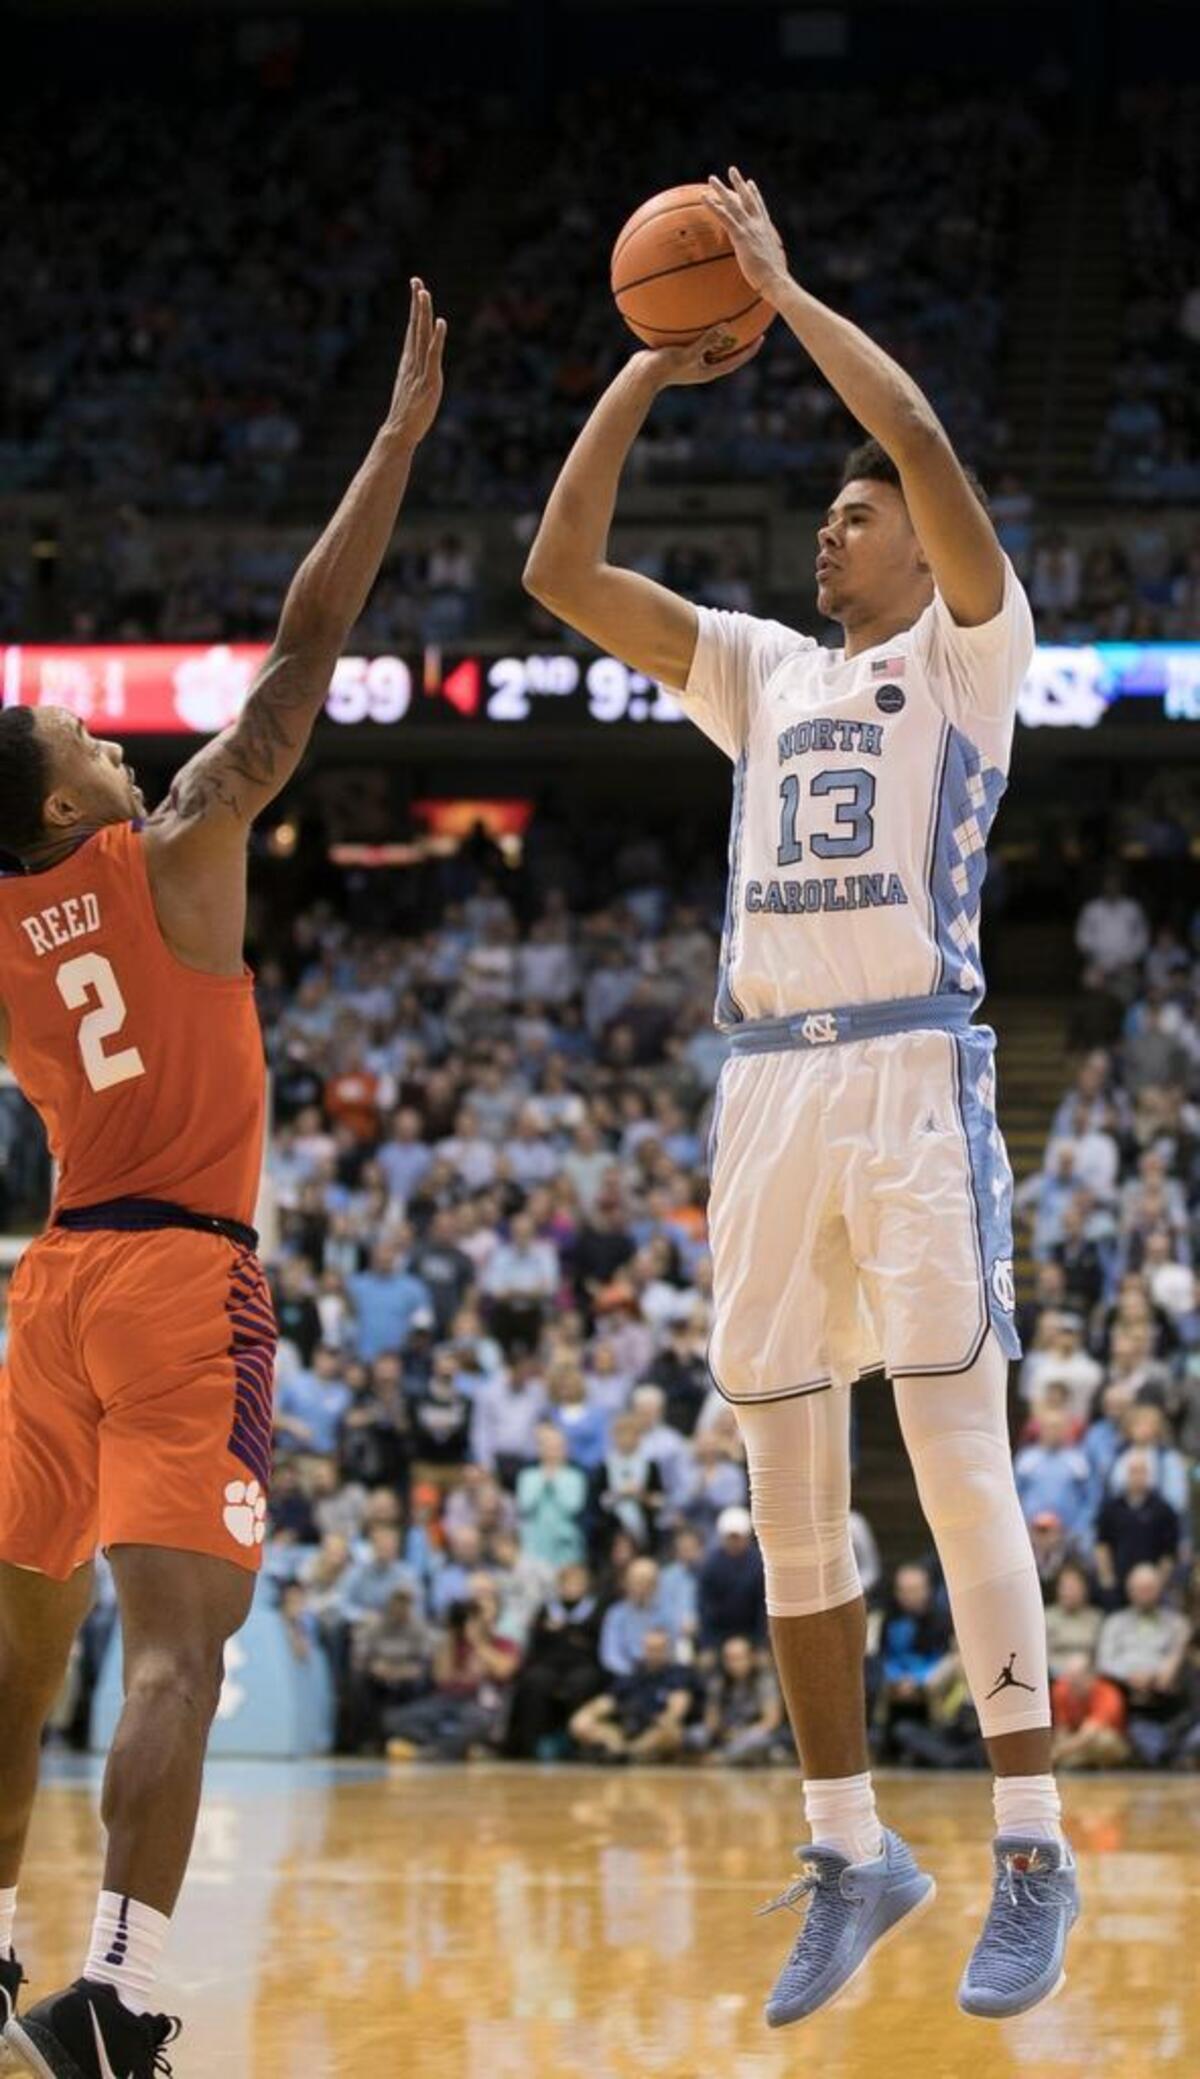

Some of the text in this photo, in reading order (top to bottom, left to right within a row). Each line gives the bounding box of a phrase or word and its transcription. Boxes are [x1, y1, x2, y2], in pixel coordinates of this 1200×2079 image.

[325, 656, 411, 724] 59
[777, 718, 883, 766] NORTH
[777, 768, 876, 866] 13
[21, 892, 101, 957] REED
[745, 872, 908, 914] CAROLINA
[56, 952, 146, 1093] 2
